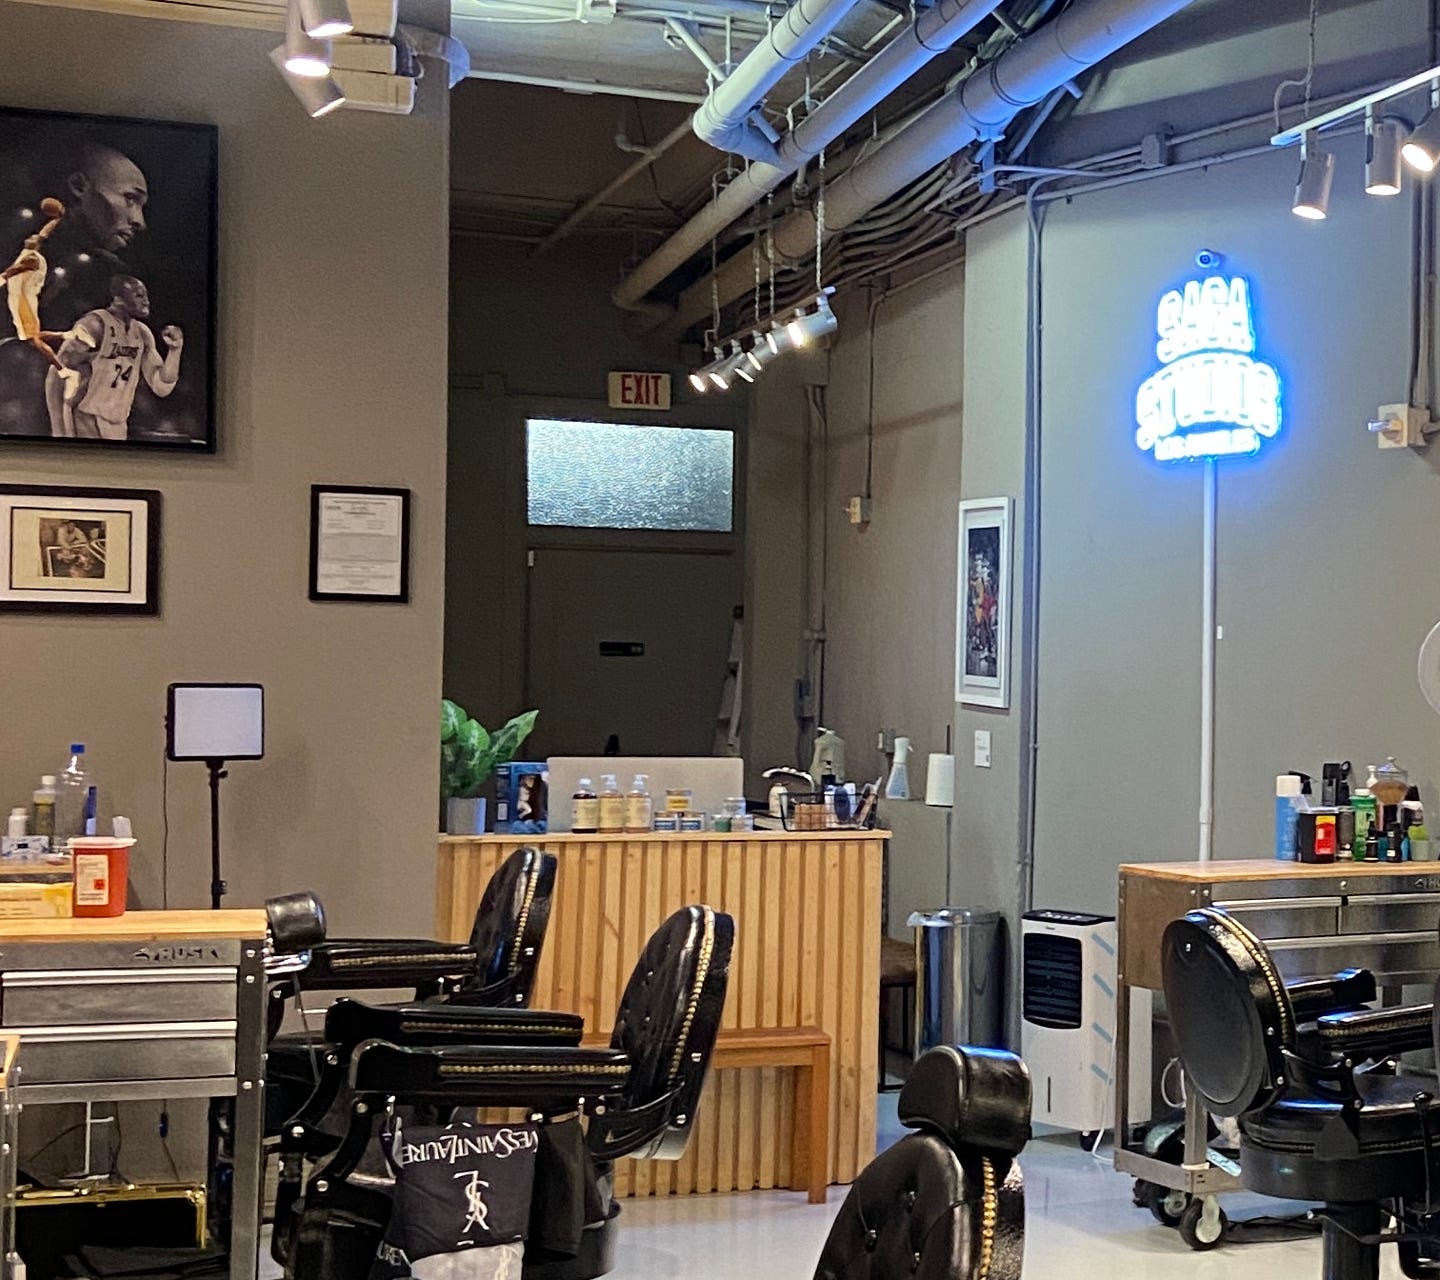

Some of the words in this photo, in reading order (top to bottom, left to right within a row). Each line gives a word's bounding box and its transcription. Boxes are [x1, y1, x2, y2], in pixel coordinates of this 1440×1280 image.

[621, 373, 662, 406] EXIT
[1137, 352, 1281, 451] STUDIOS
[402, 1134, 459, 1165] LAURE
